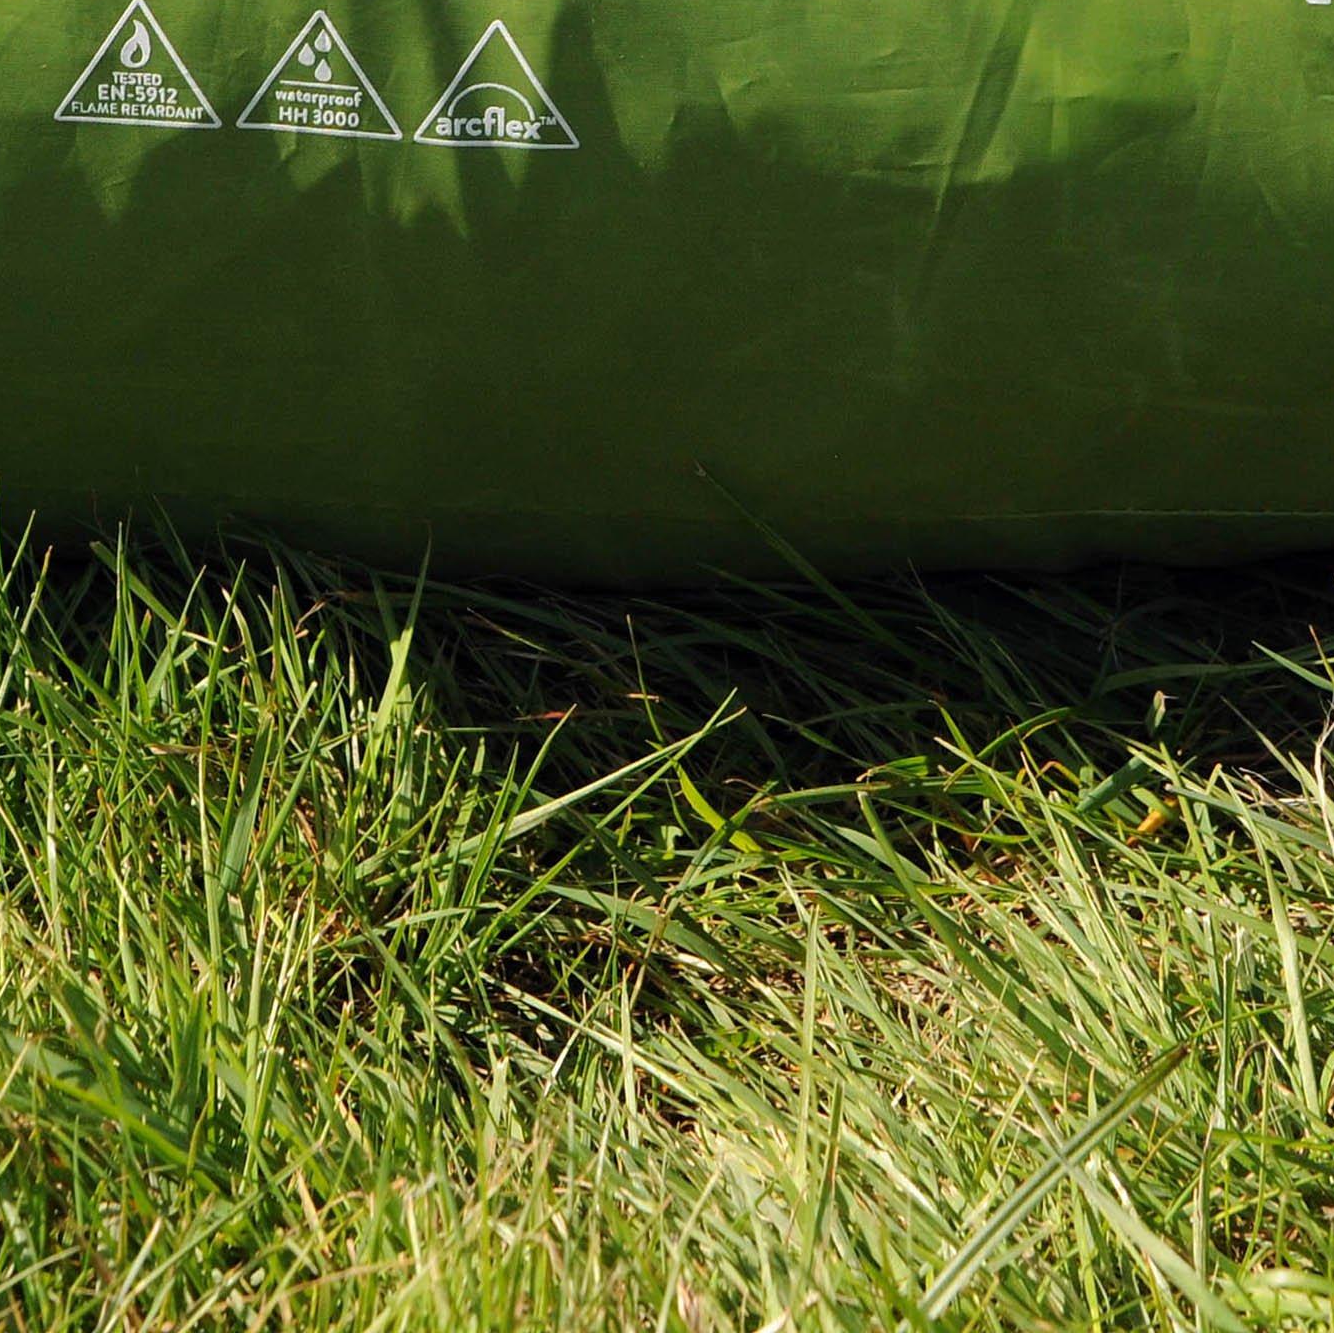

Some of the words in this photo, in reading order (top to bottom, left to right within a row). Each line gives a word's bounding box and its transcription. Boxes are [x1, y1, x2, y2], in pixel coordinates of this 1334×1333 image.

[112, 71, 163, 86] TESTED
[97, 84, 178, 104] EN-5912
[275, 89, 363, 109] waterproof
[71, 101, 118, 115] FLAME
[121, 103, 204, 119] RETARDANT
[278, 106, 308, 124] HH
[312, 109, 360, 127] 3000
